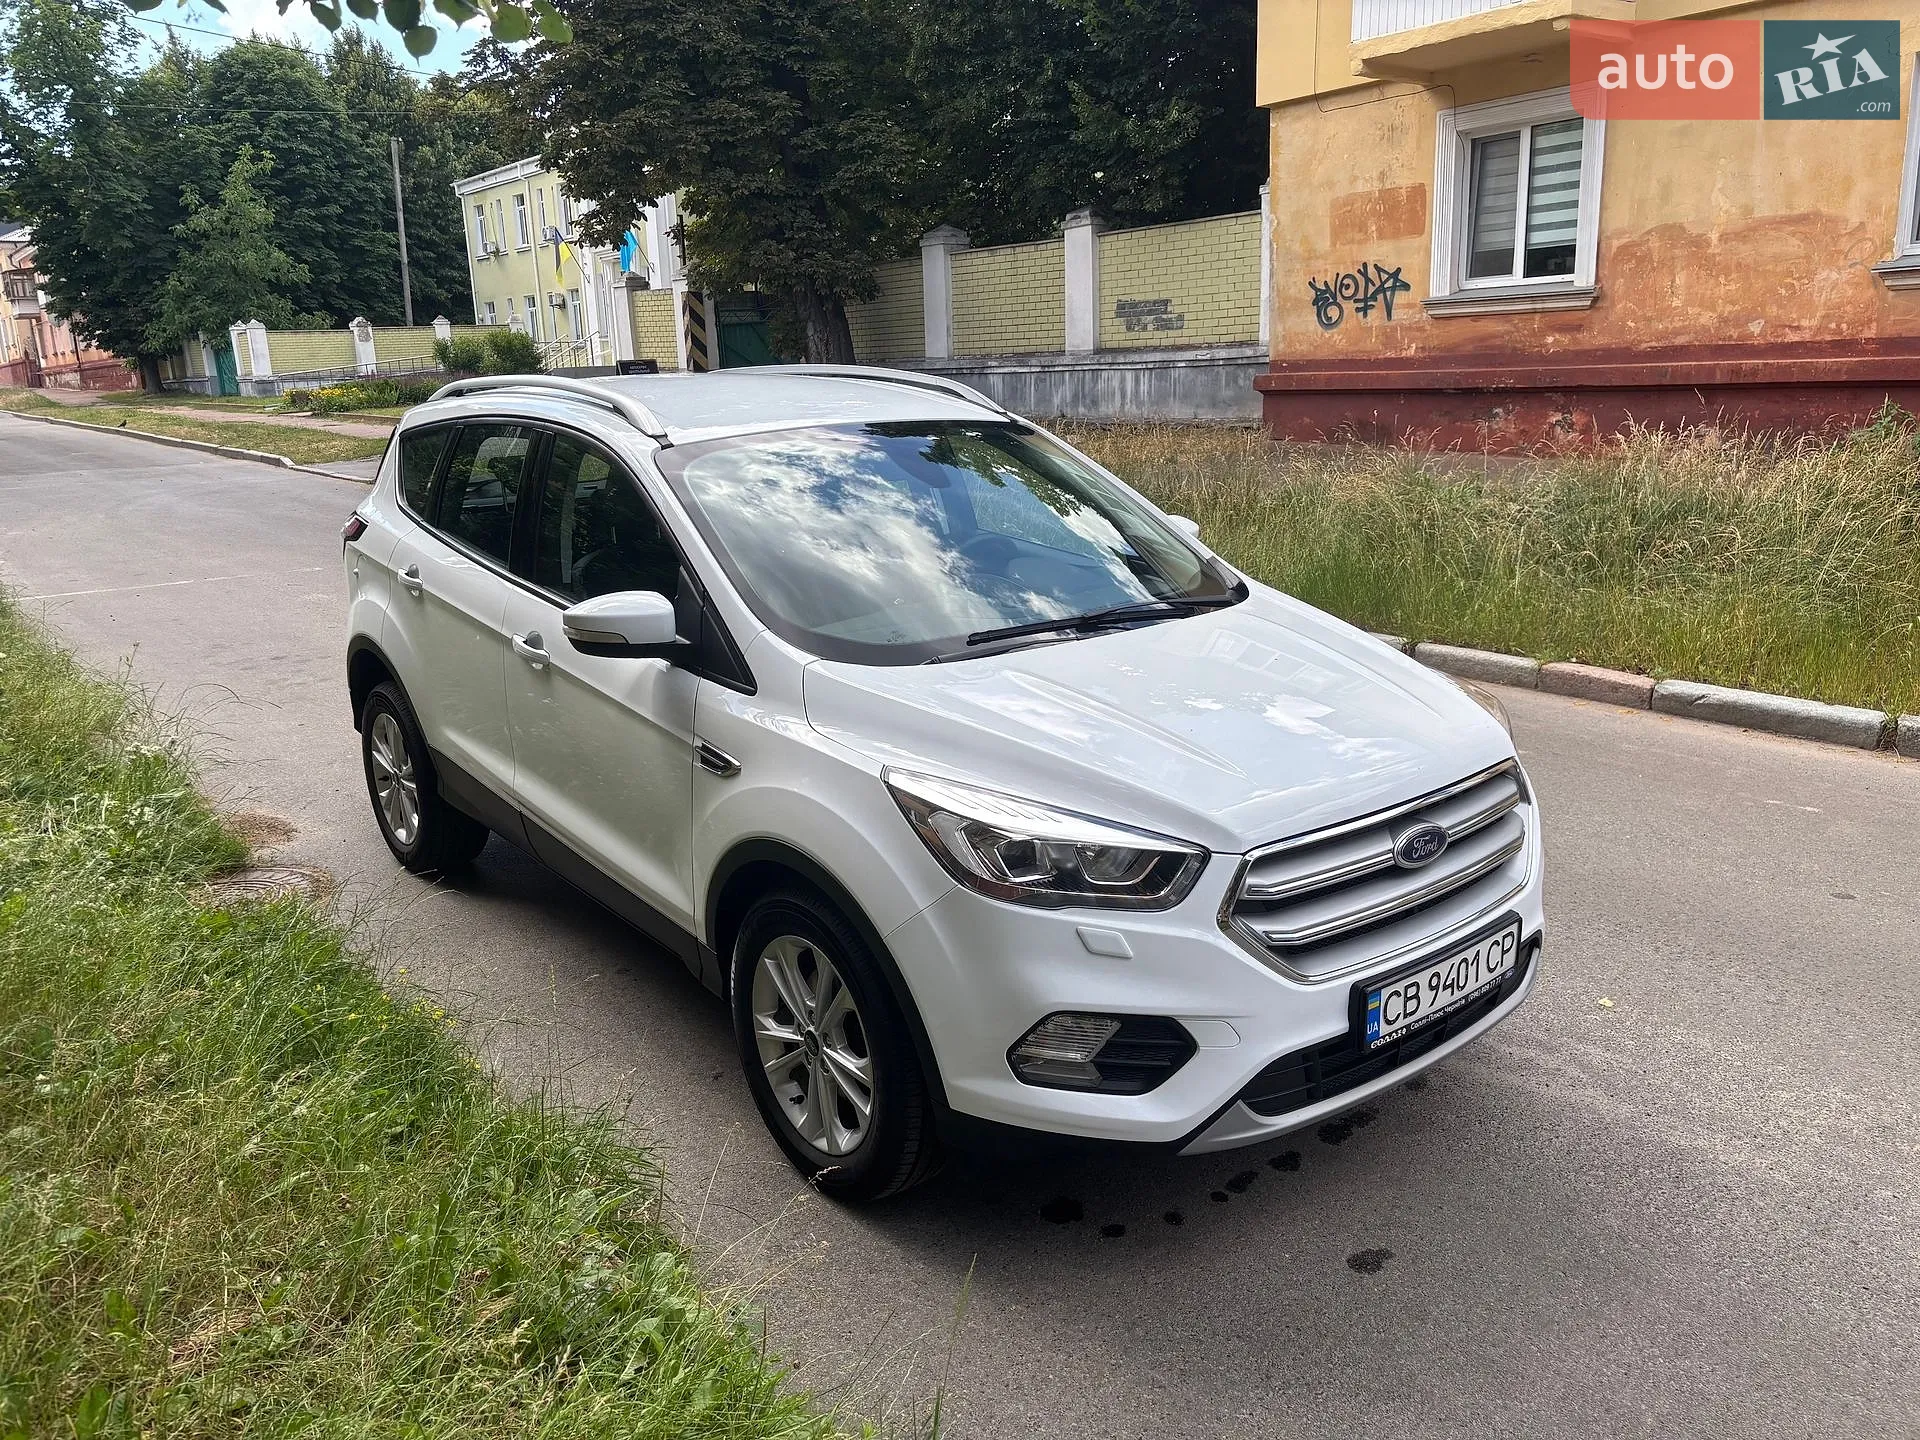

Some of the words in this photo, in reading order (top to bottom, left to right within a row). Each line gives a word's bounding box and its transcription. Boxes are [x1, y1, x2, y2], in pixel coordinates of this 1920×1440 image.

[1412, 835, 1438, 858] Ford
[1383, 980, 1421, 1026] CB
[1428, 949, 1480, 1007] 9401
[1486, 931, 1515, 973] CP
[1367, 1021, 1379, 1035] UA
